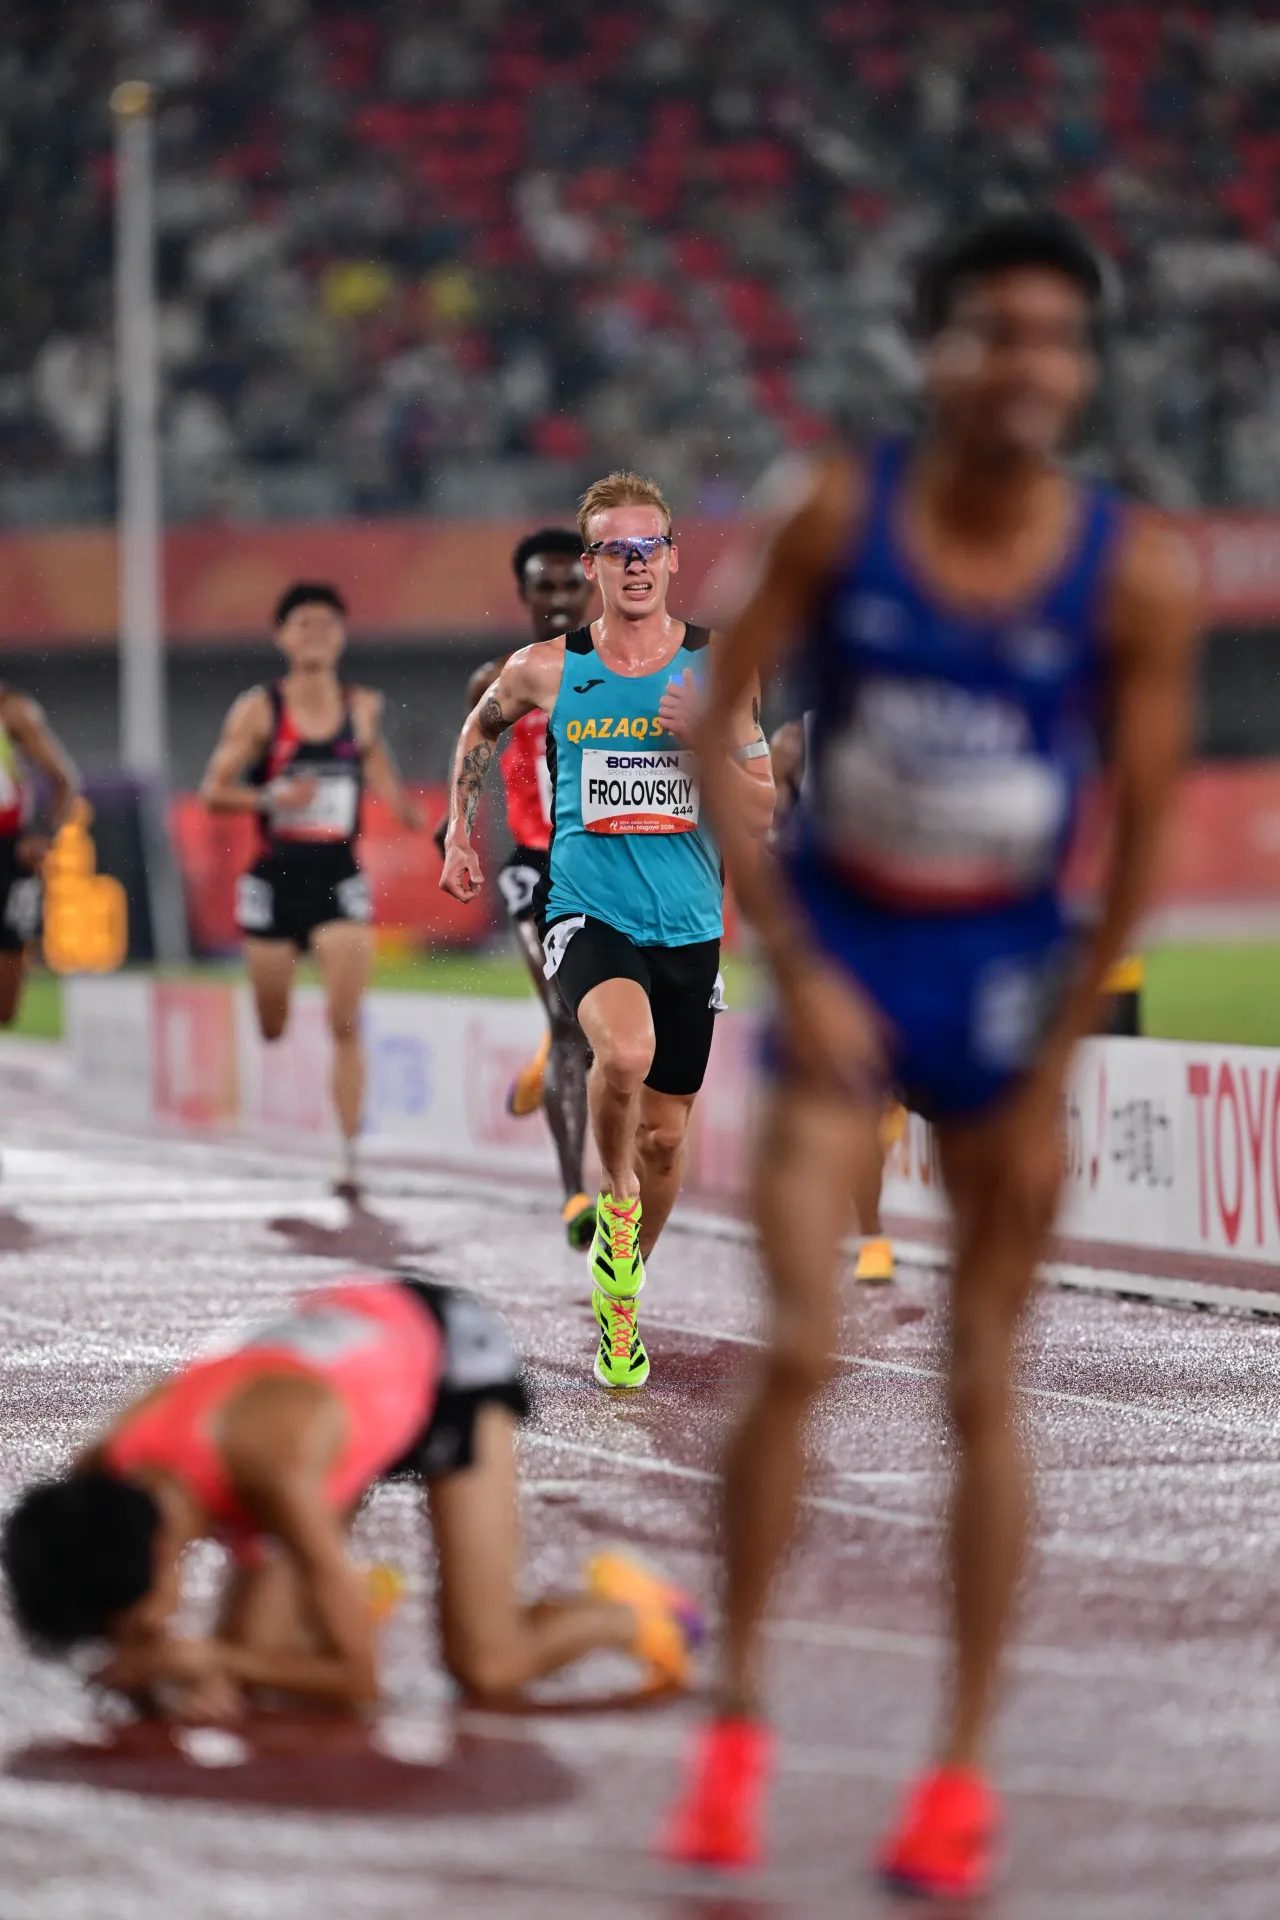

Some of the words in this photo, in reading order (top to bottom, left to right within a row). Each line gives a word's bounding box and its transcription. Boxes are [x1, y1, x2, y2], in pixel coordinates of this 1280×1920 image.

[566, 717, 675, 744] QAZAQS
[605, 756, 679, 769] BORNAN
[589, 779, 693, 806] FROLOVSKIY
[672, 805, 694, 816] 444
